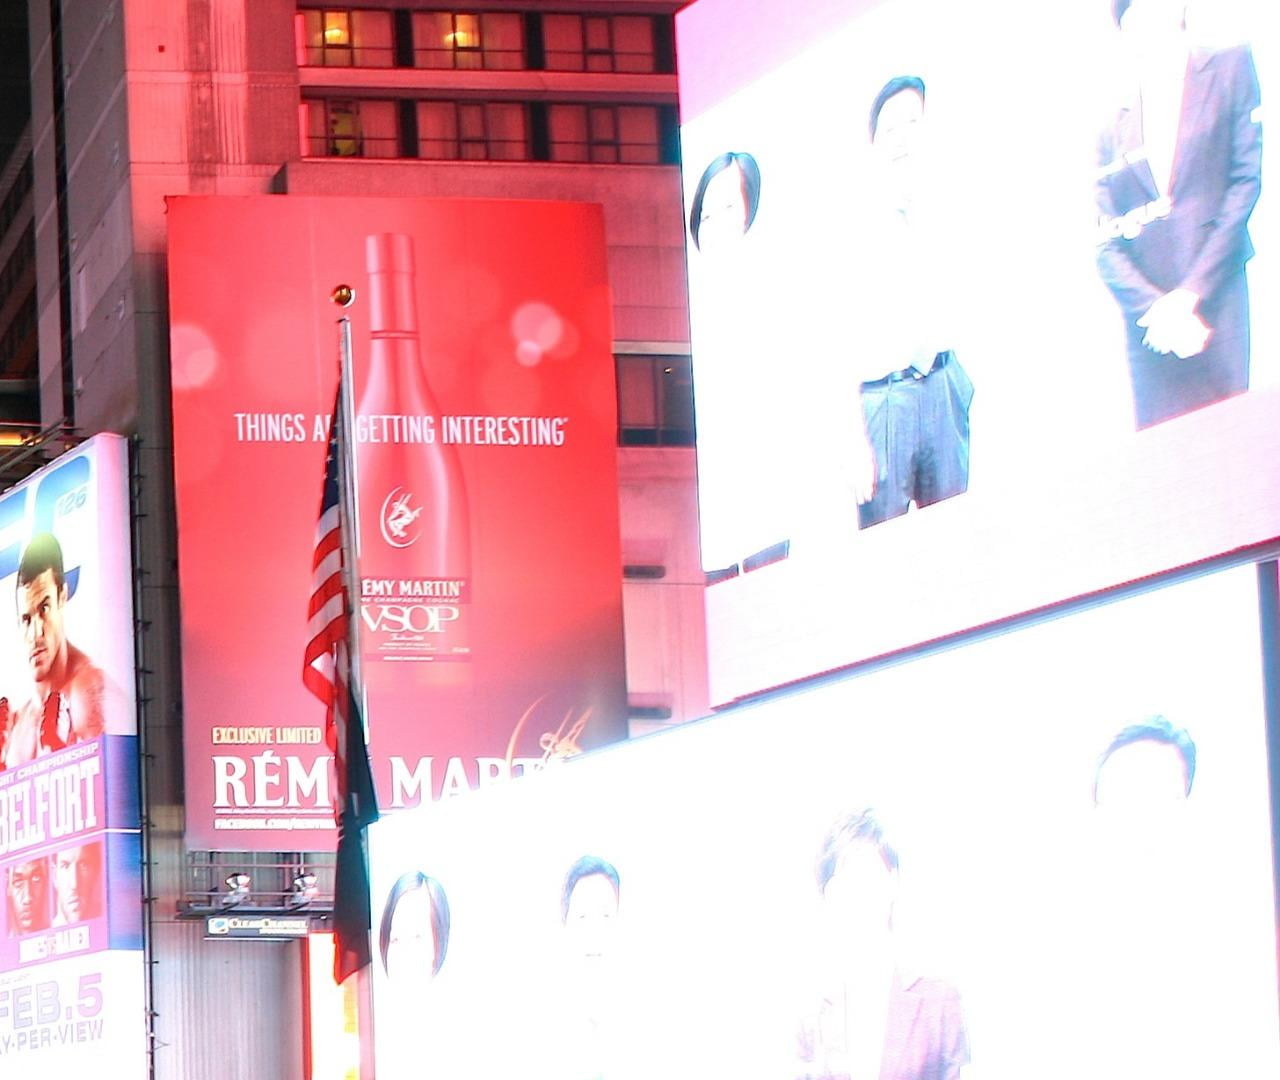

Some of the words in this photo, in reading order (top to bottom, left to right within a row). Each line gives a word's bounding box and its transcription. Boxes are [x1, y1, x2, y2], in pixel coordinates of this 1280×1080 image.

[234, 413, 305, 442] THINGS
[355, 414, 435, 443] GETTING
[441, 416, 565, 445] INTERESTING
[400, 580, 459, 595] MARTIN
[361, 605, 459, 632] VSOP
[212, 727, 274, 745] EXCLUSIVE
[276, 727, 322, 744] LIMITED
[212, 750, 335, 808] RÉM
[77, 972, 103, 1017] 5
